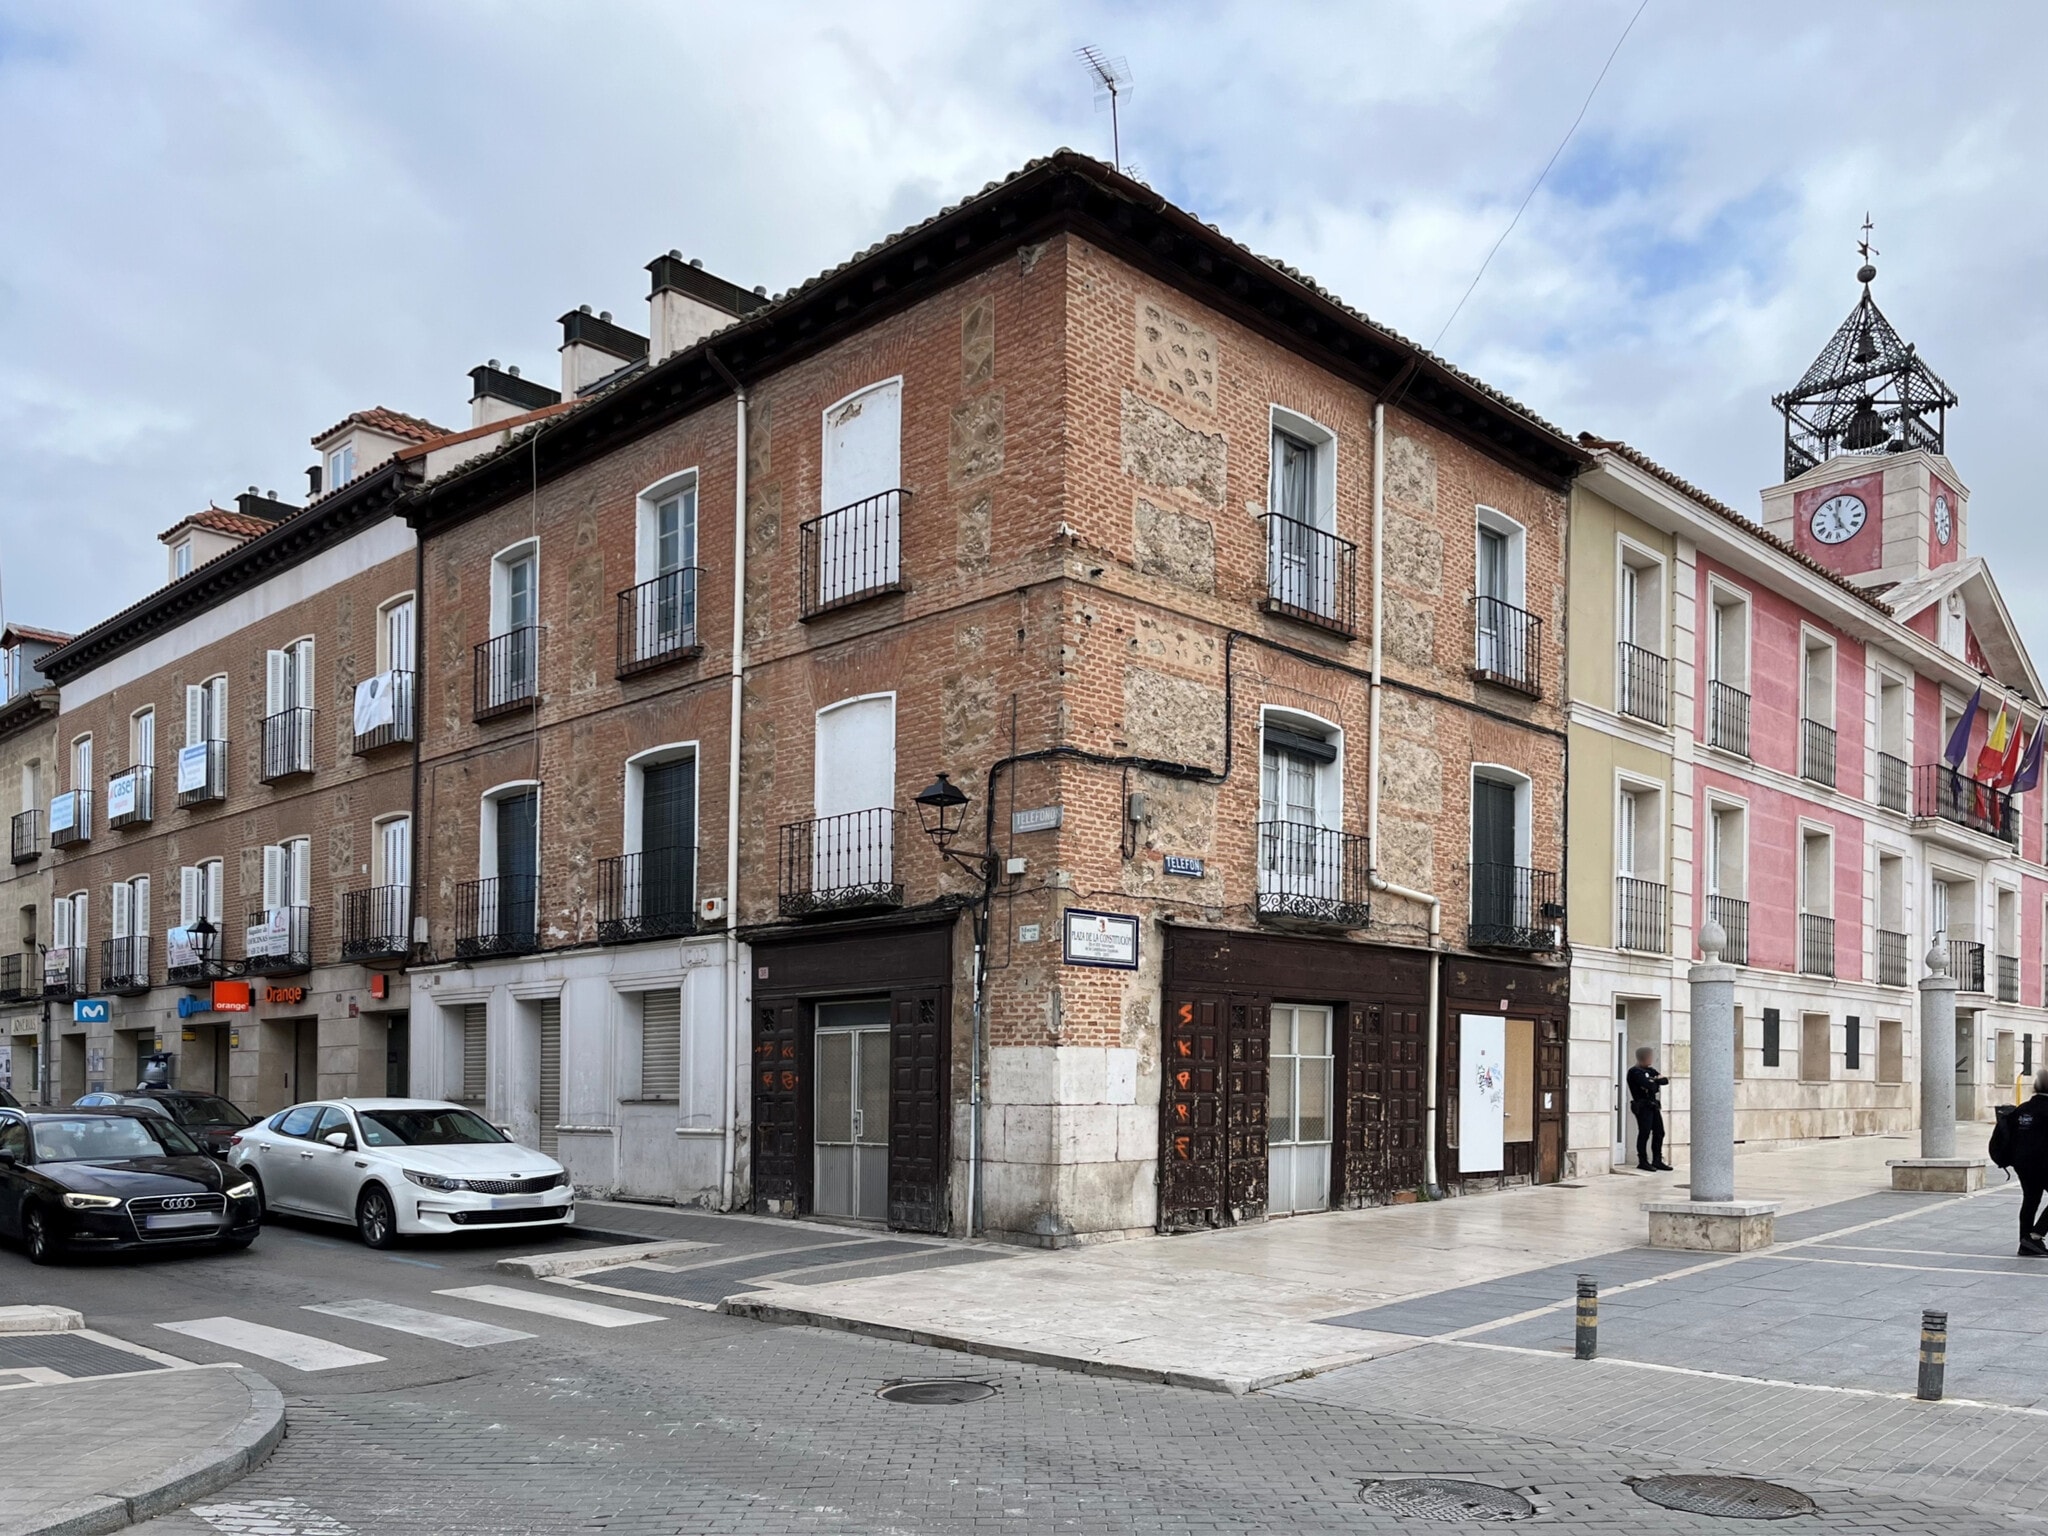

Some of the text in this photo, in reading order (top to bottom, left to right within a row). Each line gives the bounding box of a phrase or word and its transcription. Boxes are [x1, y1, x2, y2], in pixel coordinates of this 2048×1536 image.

[114, 778, 135, 798] caser
[1071, 931, 1085, 941] PLAZA
[1086, 932, 1092, 941] DE
[1093, 932, 1099, 942] LA
[265, 986, 301, 1005] Orange
[216, 1002, 246, 1011] orange
